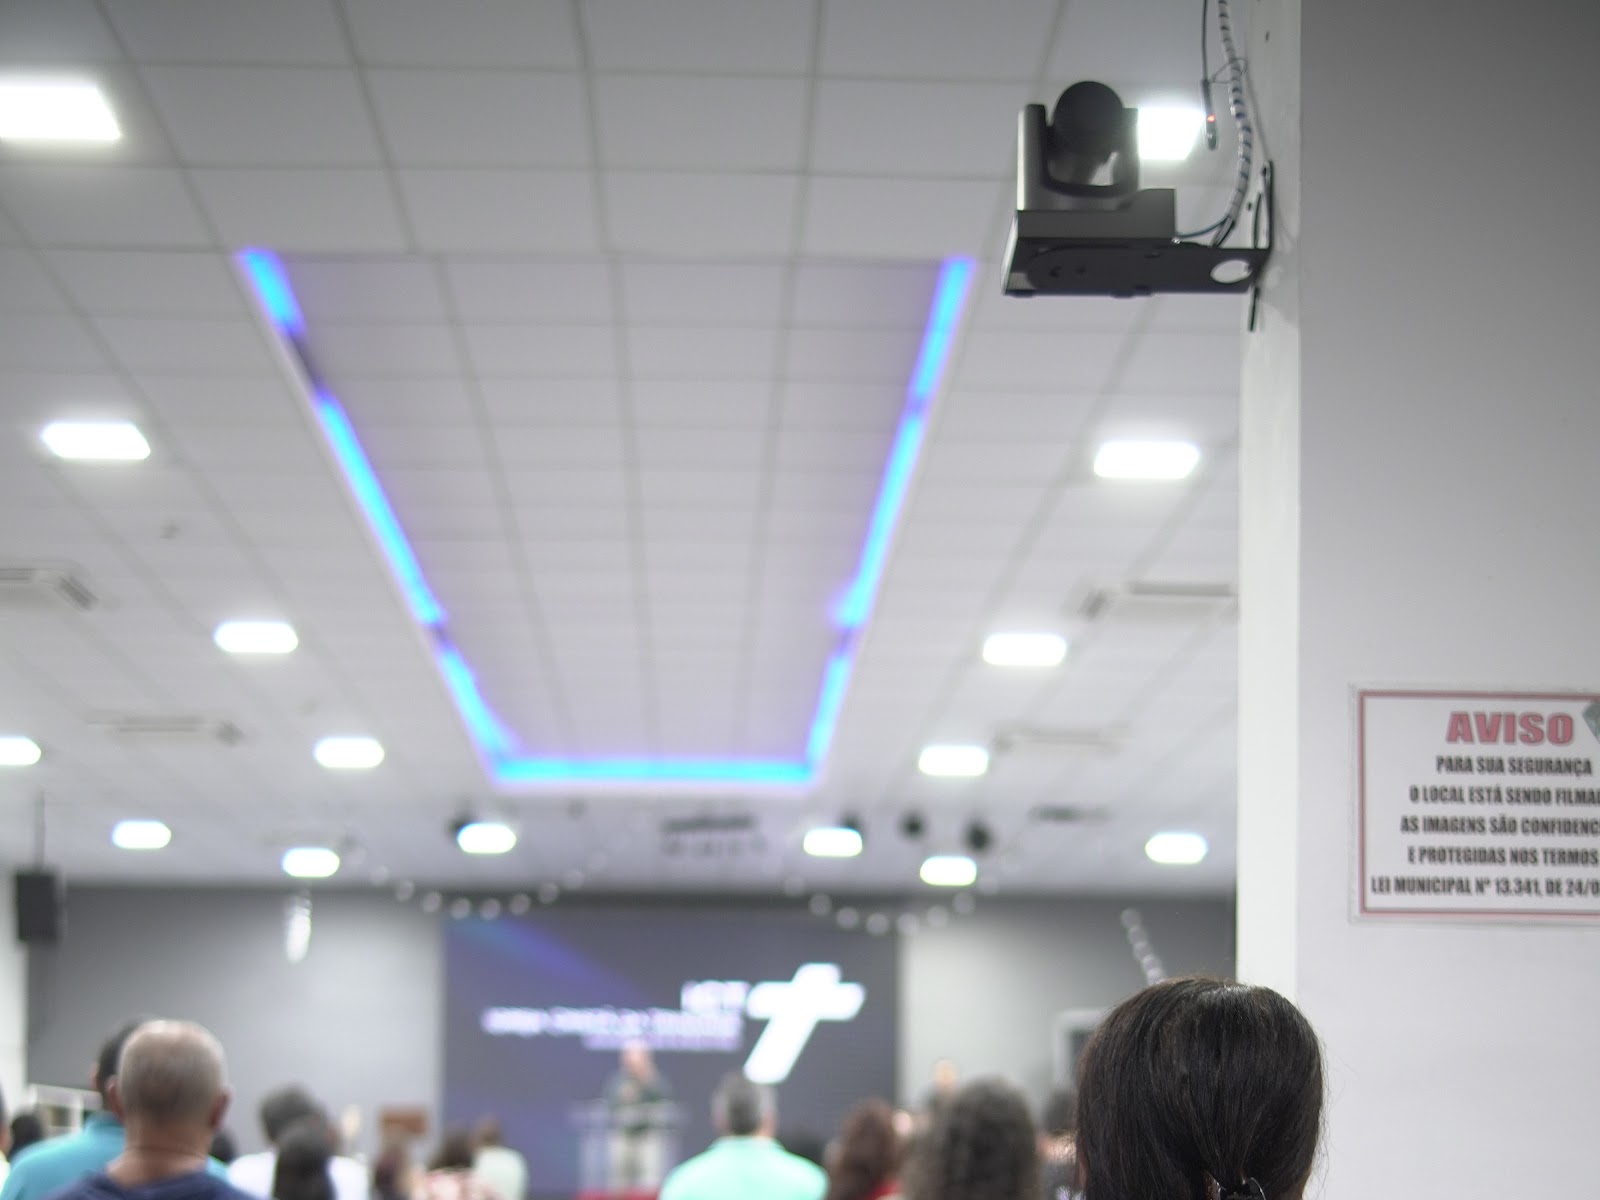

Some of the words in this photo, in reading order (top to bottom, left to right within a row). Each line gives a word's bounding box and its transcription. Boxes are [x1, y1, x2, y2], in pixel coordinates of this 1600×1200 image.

[1446, 711, 1574, 746] AVISO
[1436, 755, 1474, 774] PARA
[1477, 756, 1504, 775] SUA
[1508, 757, 1593, 778] SEGURANÇA
[1409, 785, 1419, 803] O
[1423, 786, 1464, 804] LOCAL
[1469, 783, 1501, 805] ESTÁ
[1506, 787, 1551, 806] SENDO
[1401, 815, 1419, 834] AS
[1423, 816, 1485, 835] IMAGENS
[1490, 814, 1517, 835] SÃO
[1521, 817, 1600, 836] CONFIDENC
[1408, 846, 1415, 864] E
[1418, 847, 1505, 865] PROTEGIDAS
[1510, 848, 1538, 865] NOS
[1541, 848, 1599, 866] TERMOS
[1371, 877, 1390, 894] LEI
[1394, 877, 1471, 895] MUNICIPAL
[1546, 879, 1562, 896] DE
